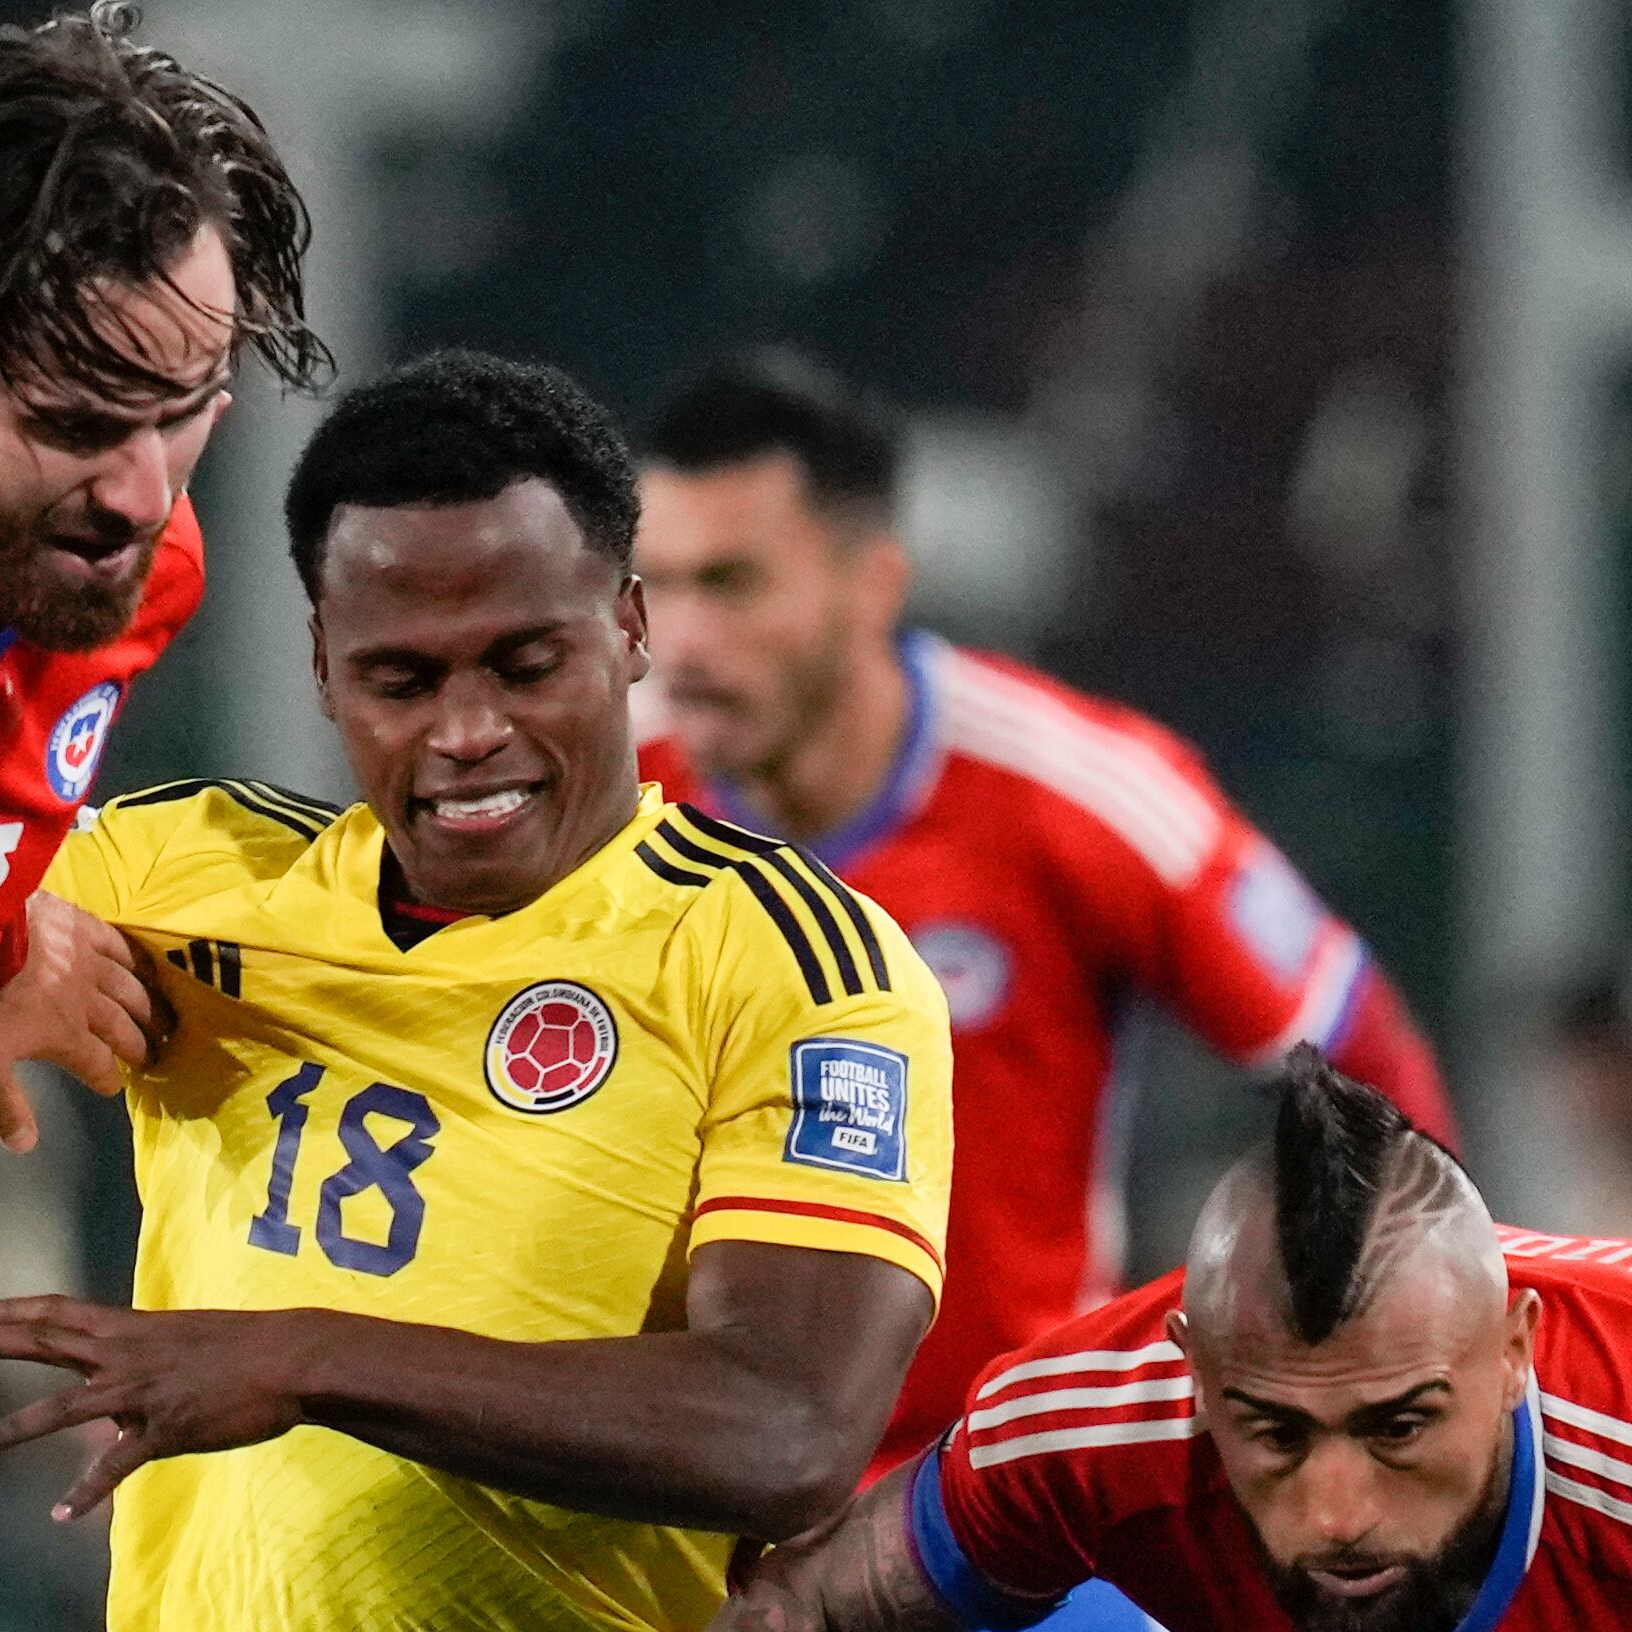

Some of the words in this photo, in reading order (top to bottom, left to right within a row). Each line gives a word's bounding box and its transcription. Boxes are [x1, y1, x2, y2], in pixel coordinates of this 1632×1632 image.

[820, 1060, 889, 1088] FOOTBALL
[821, 1077, 891, 1112] UNITES
[819, 1101, 847, 1123] the
[848, 1104, 895, 1137] World
[839, 1132, 868, 1148] FIFA
[247, 1062, 440, 1277] 18
